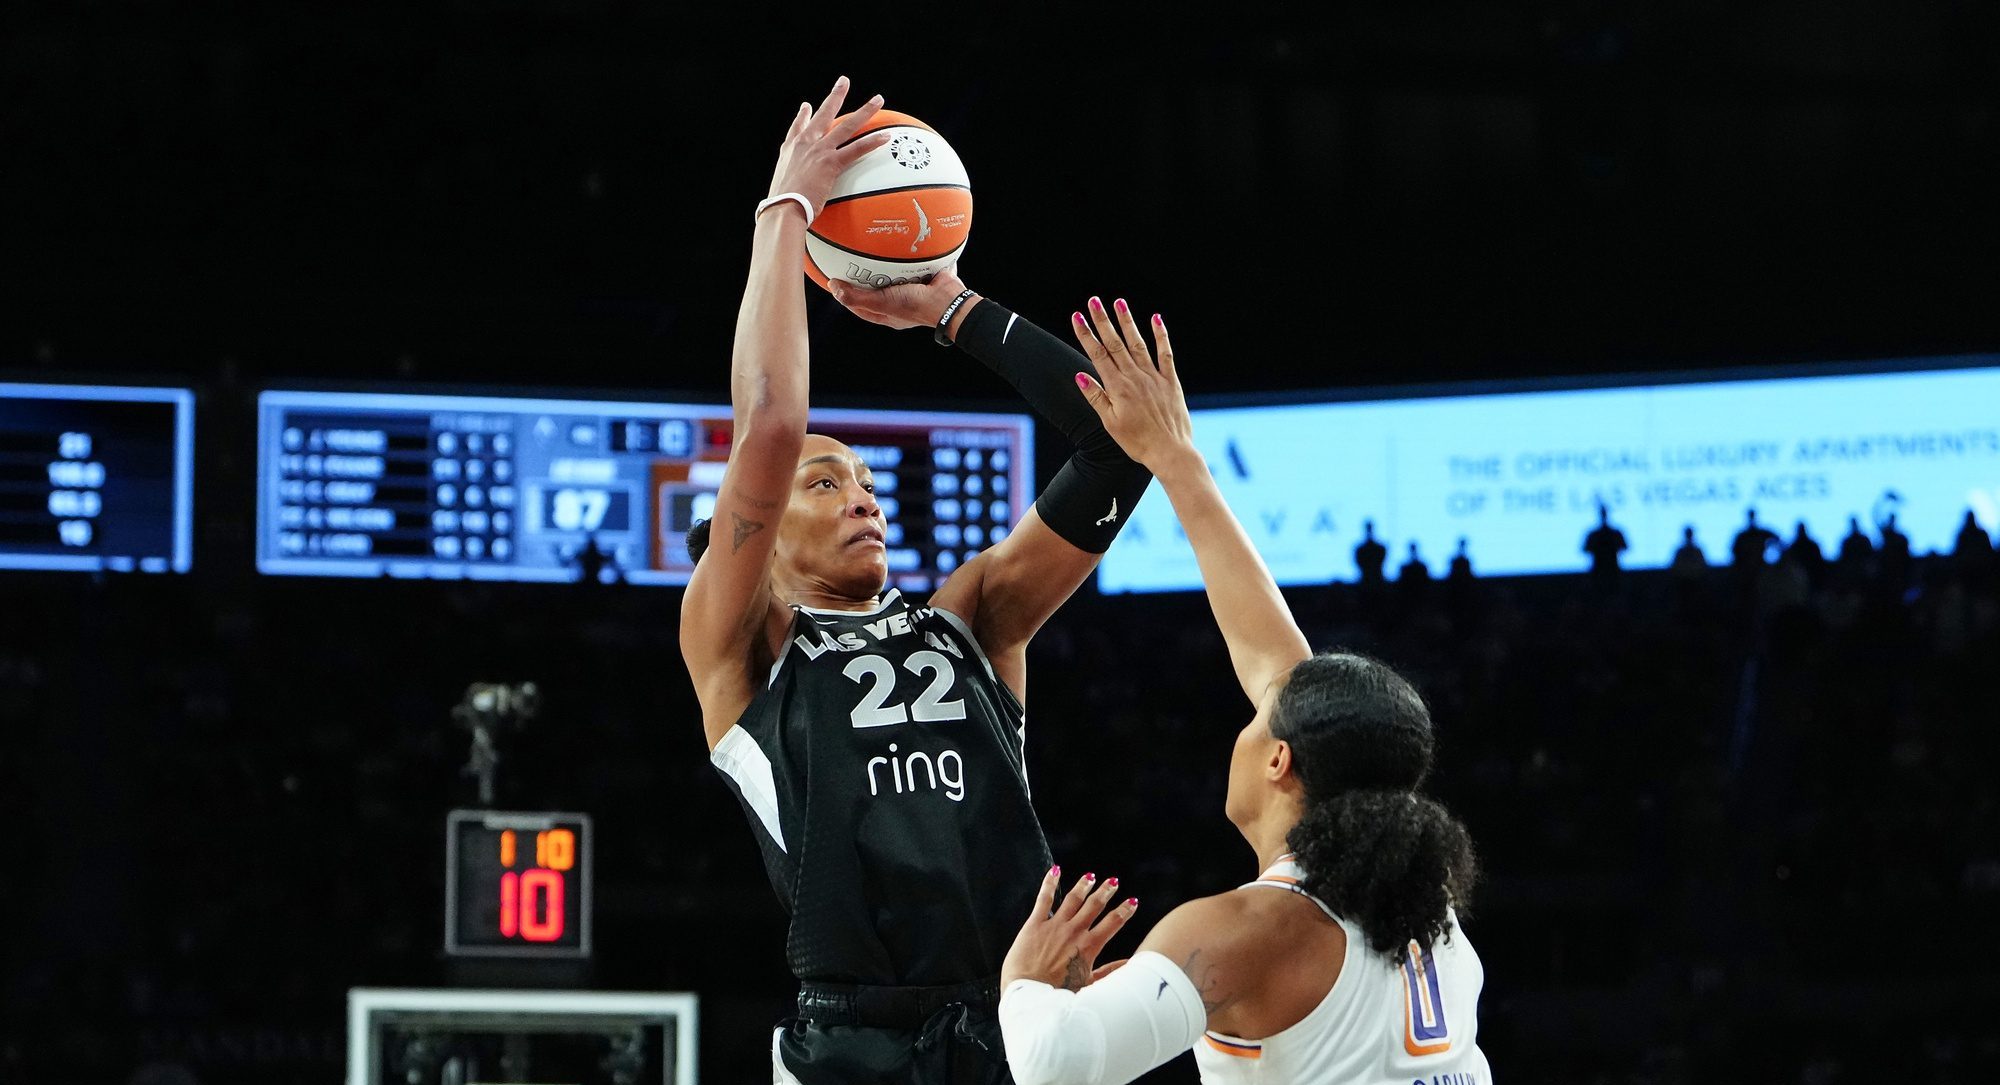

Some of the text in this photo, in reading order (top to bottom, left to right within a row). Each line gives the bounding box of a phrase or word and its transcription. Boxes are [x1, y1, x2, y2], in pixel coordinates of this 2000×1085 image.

[940, 296, 964, 326] ROMANS
[1447, 457, 1500, 478] THE
[1514, 451, 1648, 477] OFFICIAL
[1661, 442, 1778, 471] LUXURY
[553, 488, 611, 531] 87
[1446, 490, 1487, 515] OF
[1502, 488, 1554, 512] THE
[1639, 476, 1739, 507] VEGAS
[1755, 472, 1828, 498] ACES
[794, 630, 867, 661] LAS
[842, 650, 967, 728] 22
[867, 743, 965, 802] ring
[500, 869, 565, 942] 10
[1401, 940, 1452, 1057] 0
